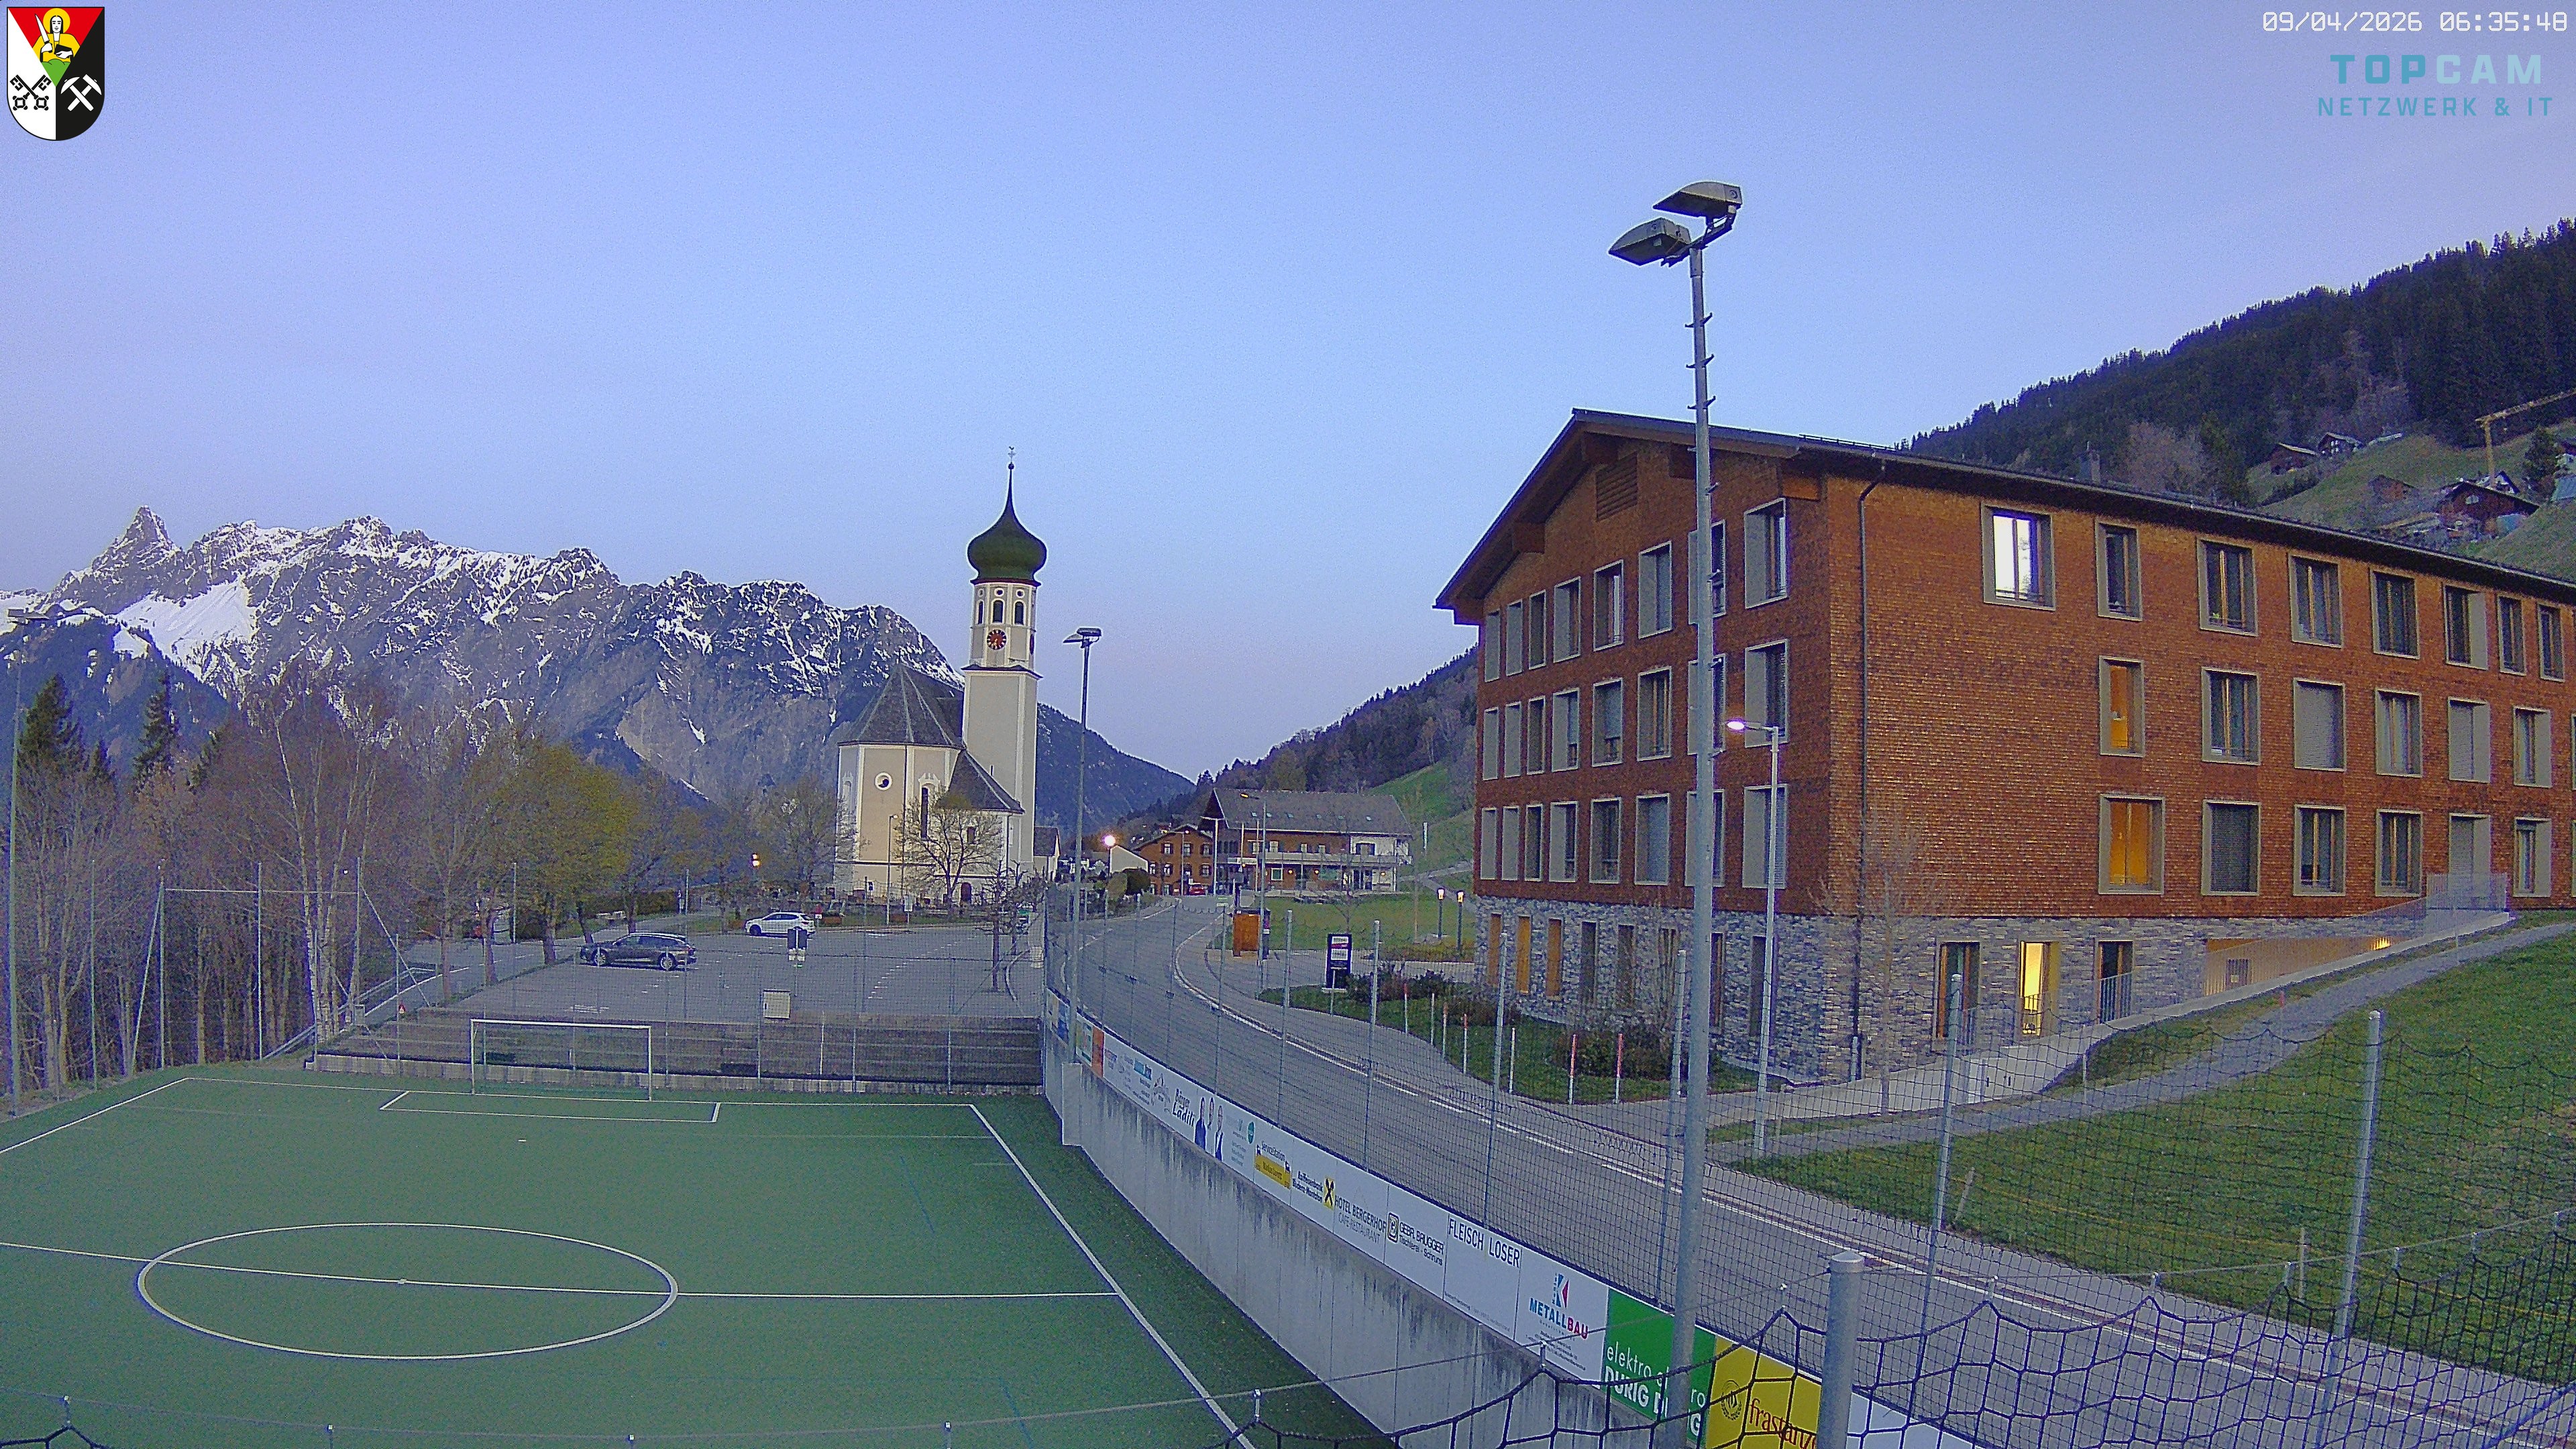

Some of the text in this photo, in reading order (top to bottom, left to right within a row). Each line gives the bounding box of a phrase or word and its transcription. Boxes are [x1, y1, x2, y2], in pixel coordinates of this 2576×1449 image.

[1335, 1194, 1351, 1214] HOTEL
[1448, 1218, 1520, 1269] FLEISCH LOSER
[1529, 1297, 1589, 1340] METALLBAU
[1607, 1341, 1652, 1379] elektro
